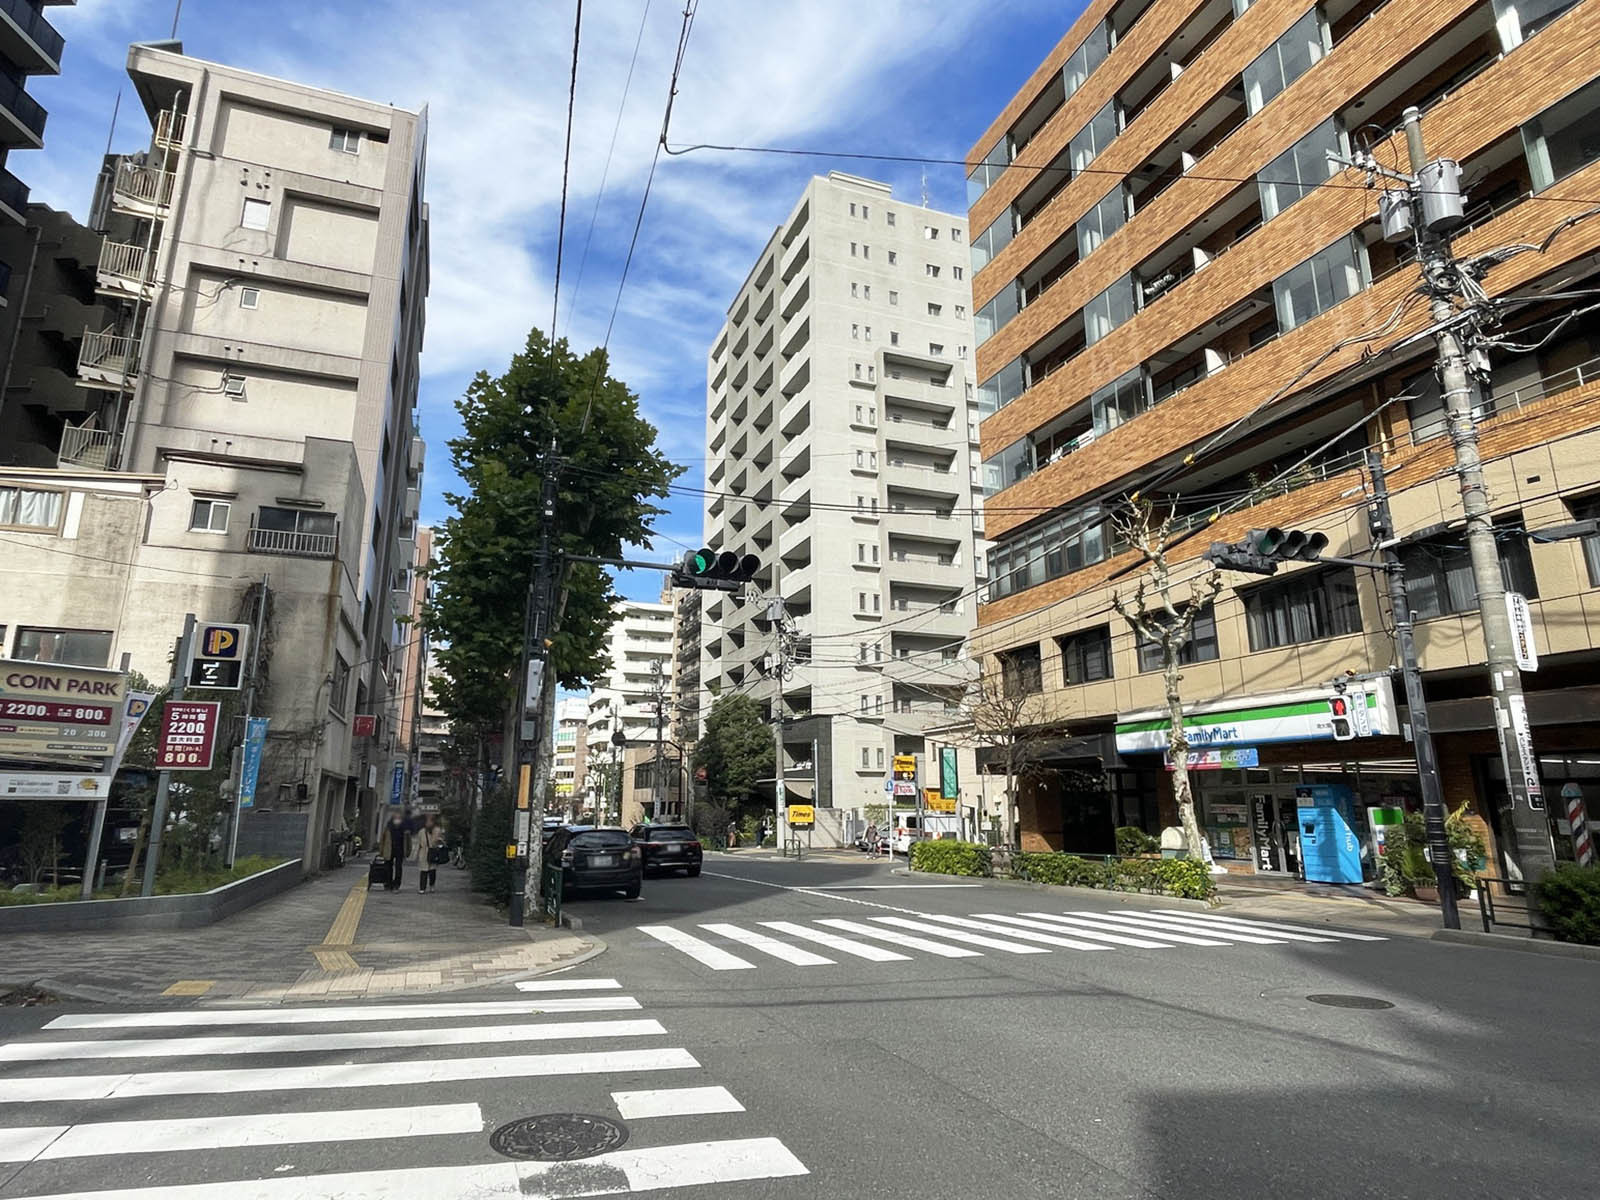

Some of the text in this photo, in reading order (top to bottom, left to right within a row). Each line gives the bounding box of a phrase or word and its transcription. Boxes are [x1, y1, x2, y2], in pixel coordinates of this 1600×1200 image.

[6, 673, 119, 696] COIN PARK
[6, 703, 47, 717] 2200
[75, 708, 103, 720] 800
[792, 810, 811, 818] Times
[1254, 793, 1273, 871] FamilyMart
